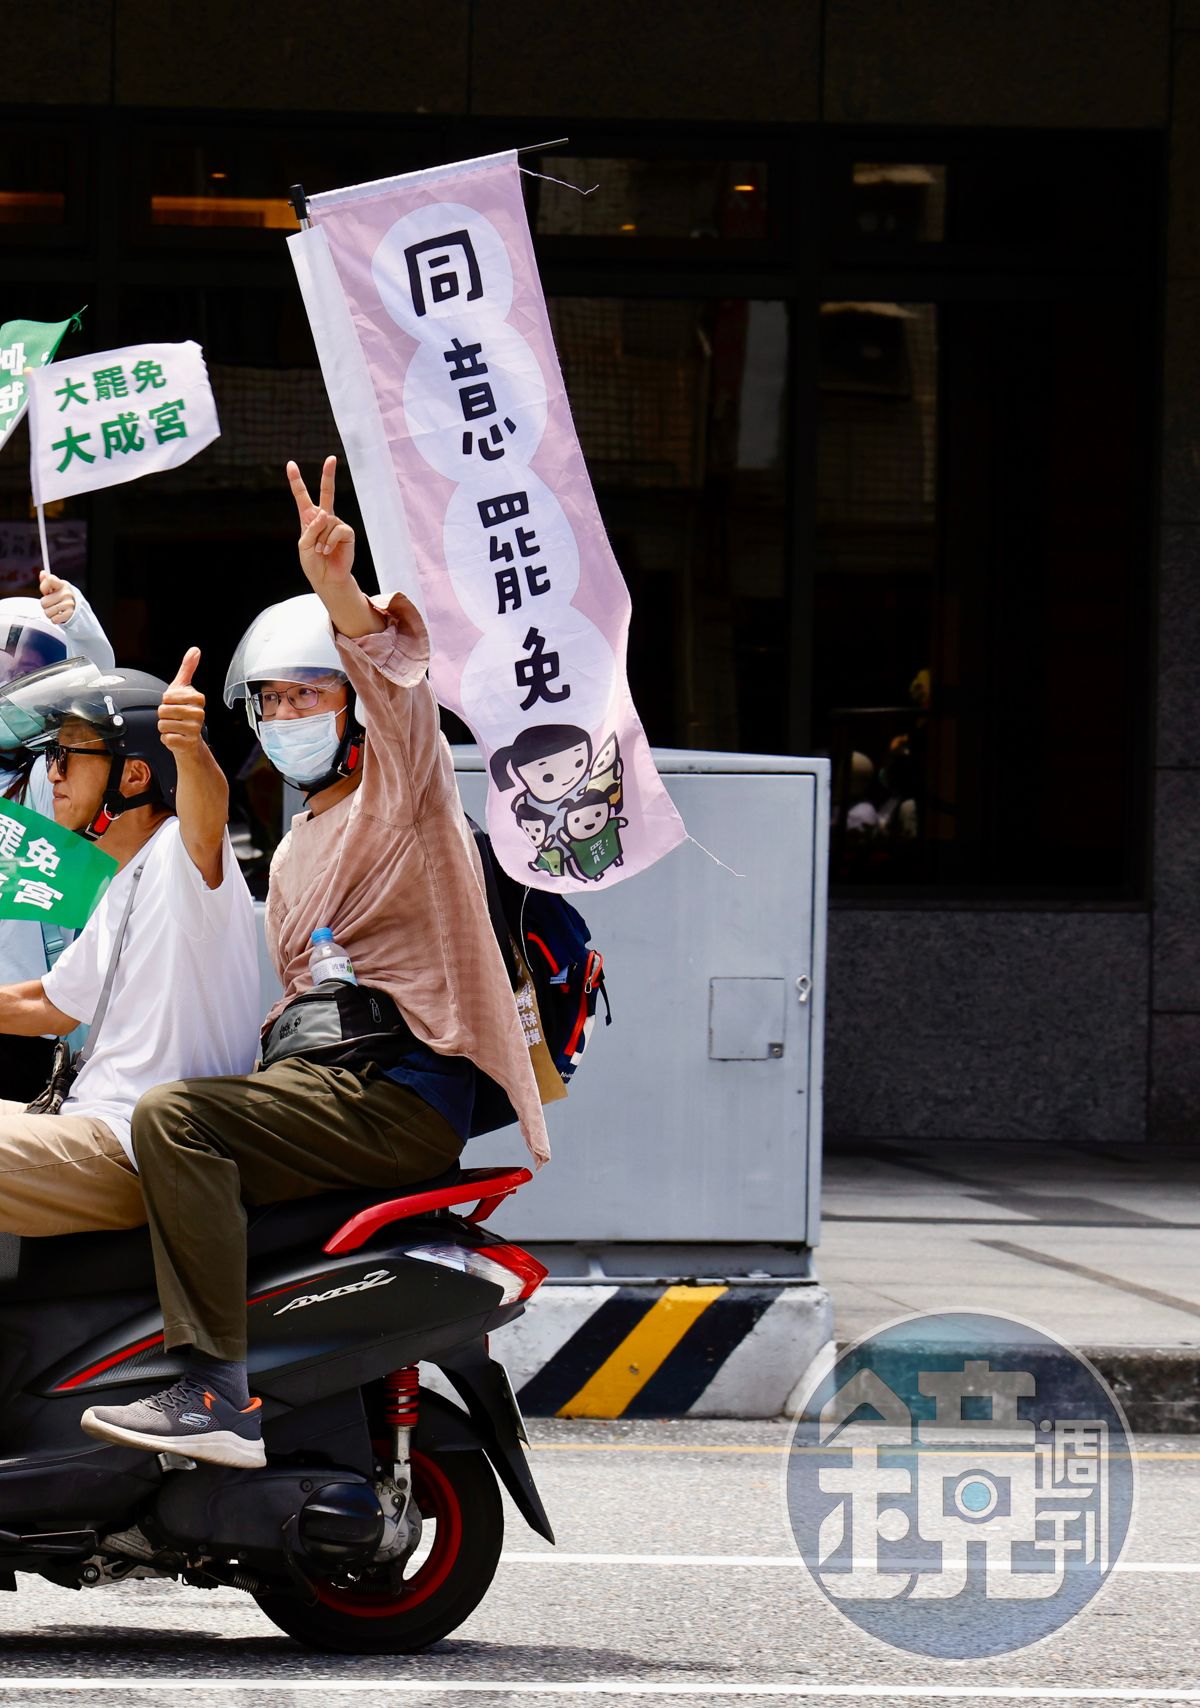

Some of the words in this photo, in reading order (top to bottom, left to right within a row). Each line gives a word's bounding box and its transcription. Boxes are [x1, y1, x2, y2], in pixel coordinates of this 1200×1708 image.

[54, 358, 168, 413] 大罷免
[50, 397, 189, 474] 大成宮
[403, 229, 571, 711] 同意罷免
